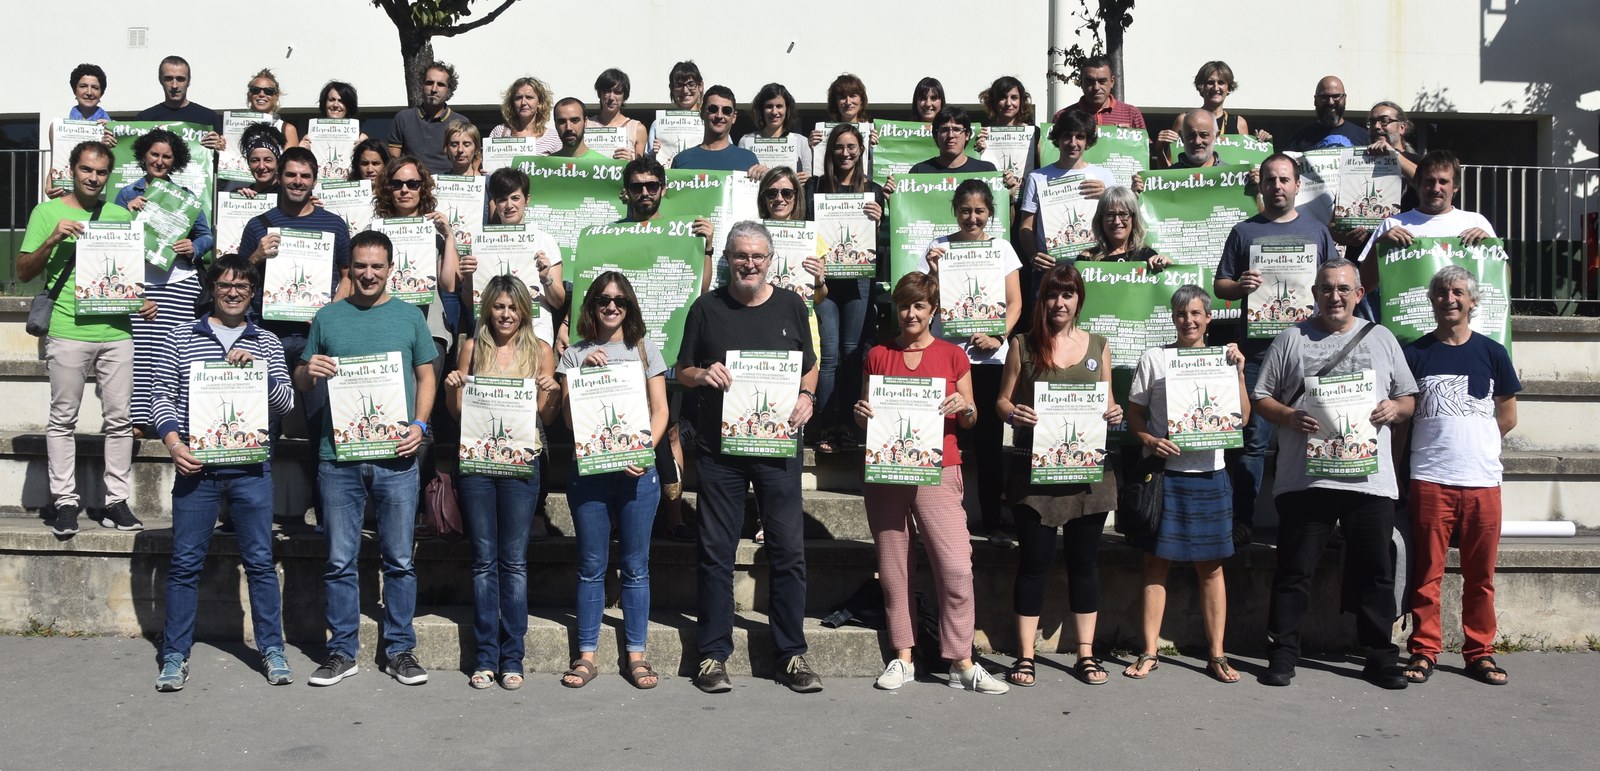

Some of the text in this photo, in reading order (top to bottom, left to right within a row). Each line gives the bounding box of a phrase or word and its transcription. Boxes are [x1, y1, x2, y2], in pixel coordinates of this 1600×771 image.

[1116, 128, 1143, 140] 2018
[1244, 140, 1269, 152] 2018
[517, 161, 622, 181] Alternatiba 2018
[665, 174, 720, 192] ternatiba
[1144, 172, 1216, 192] Alternatiba
[586, 221, 696, 238] Alternatiba 201
[1385, 241, 1509, 265] Alternatiba 2018
[1080, 267, 1198, 286] Alternatiba 2018
[1212, 308, 1241, 320] BAIO
